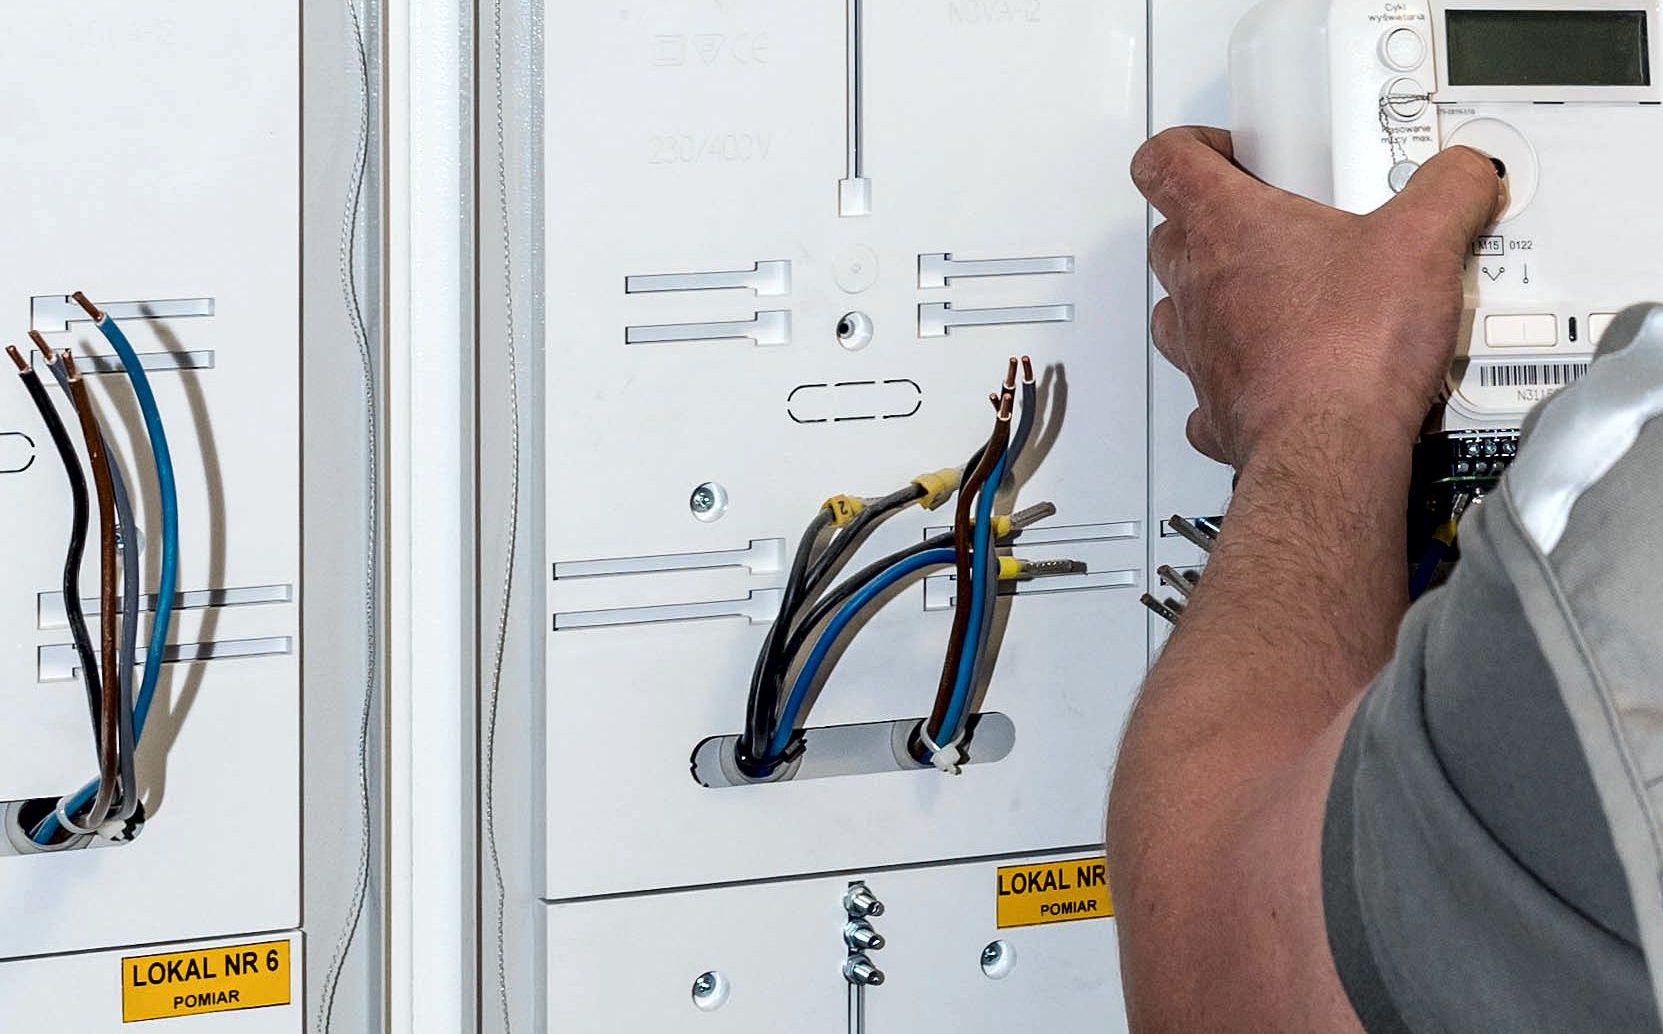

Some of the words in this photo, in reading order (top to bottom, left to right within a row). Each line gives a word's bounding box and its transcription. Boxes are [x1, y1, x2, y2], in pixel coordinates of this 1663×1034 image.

[1509, 239, 1533, 251] 0122
[999, 868, 1071, 896] LOKAL
[1077, 864, 1106, 888] NR
[1040, 899, 1097, 916] POMIAR
[133, 956, 216, 987] LOKAL
[225, 951, 258, 976] NR
[266, 949, 279, 972] 6
[174, 990, 240, 1009] POMIAR
